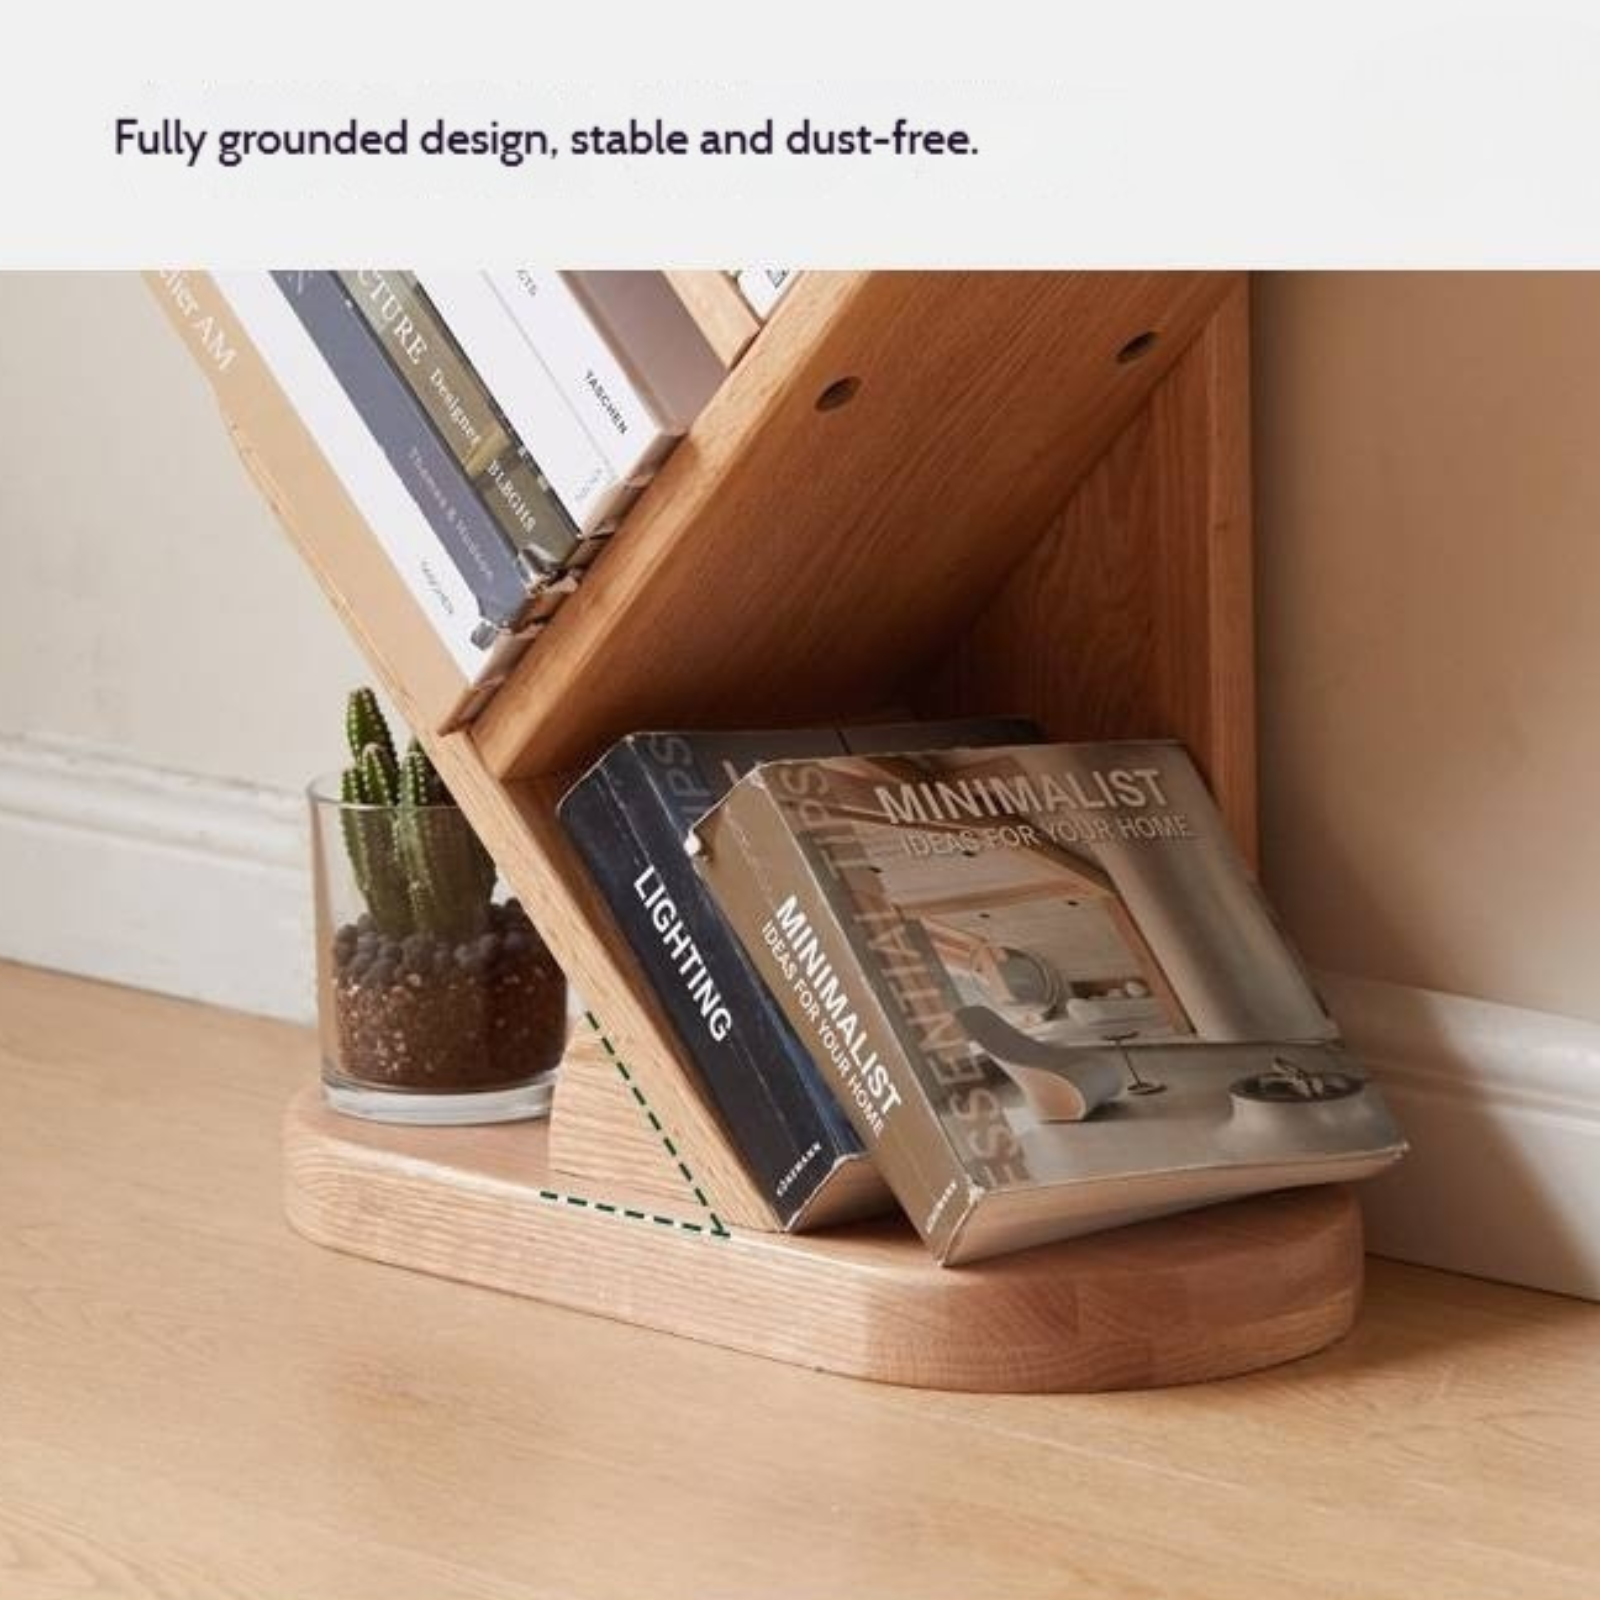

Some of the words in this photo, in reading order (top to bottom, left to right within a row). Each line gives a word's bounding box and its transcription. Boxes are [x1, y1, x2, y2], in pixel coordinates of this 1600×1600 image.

[190, 315, 237, 370] AM
[651, 735, 712, 825] IPS
[874, 768, 1168, 824] MINIMALIST
[903, 830, 981, 858] IDEAS
[987, 823, 1041, 849] FOR
[1048, 817, 1110, 844] YOUR
[1120, 813, 1190, 839] HOME
[633, 866, 732, 1042] LIGHTING
[760, 921, 798, 982] IDEAS
[793, 977, 821, 1024] FOR
[816, 1020, 852, 1075] YOUR
[848, 1070, 887, 1138] HOME
[775, 894, 902, 1116] MINIMALIST
